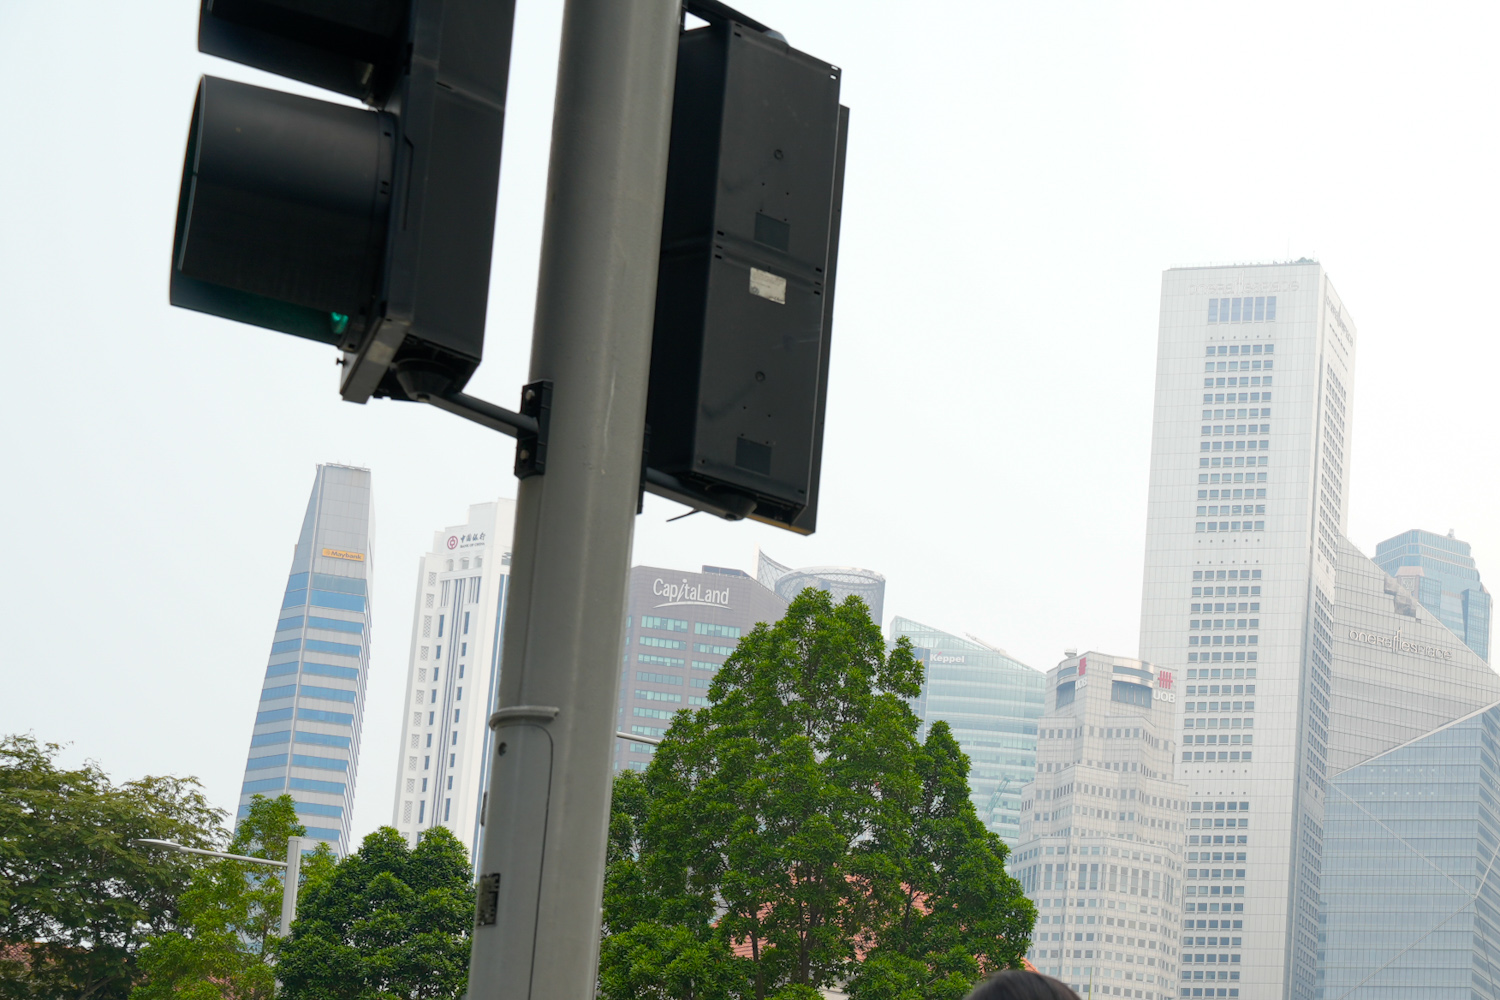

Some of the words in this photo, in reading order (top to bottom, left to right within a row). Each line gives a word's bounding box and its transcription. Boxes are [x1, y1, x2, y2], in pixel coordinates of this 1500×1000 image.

[330, 550, 362, 560] Maybank
[653, 578, 730, 605] CapitaLand
[1153, 689, 1176, 703] UOB
